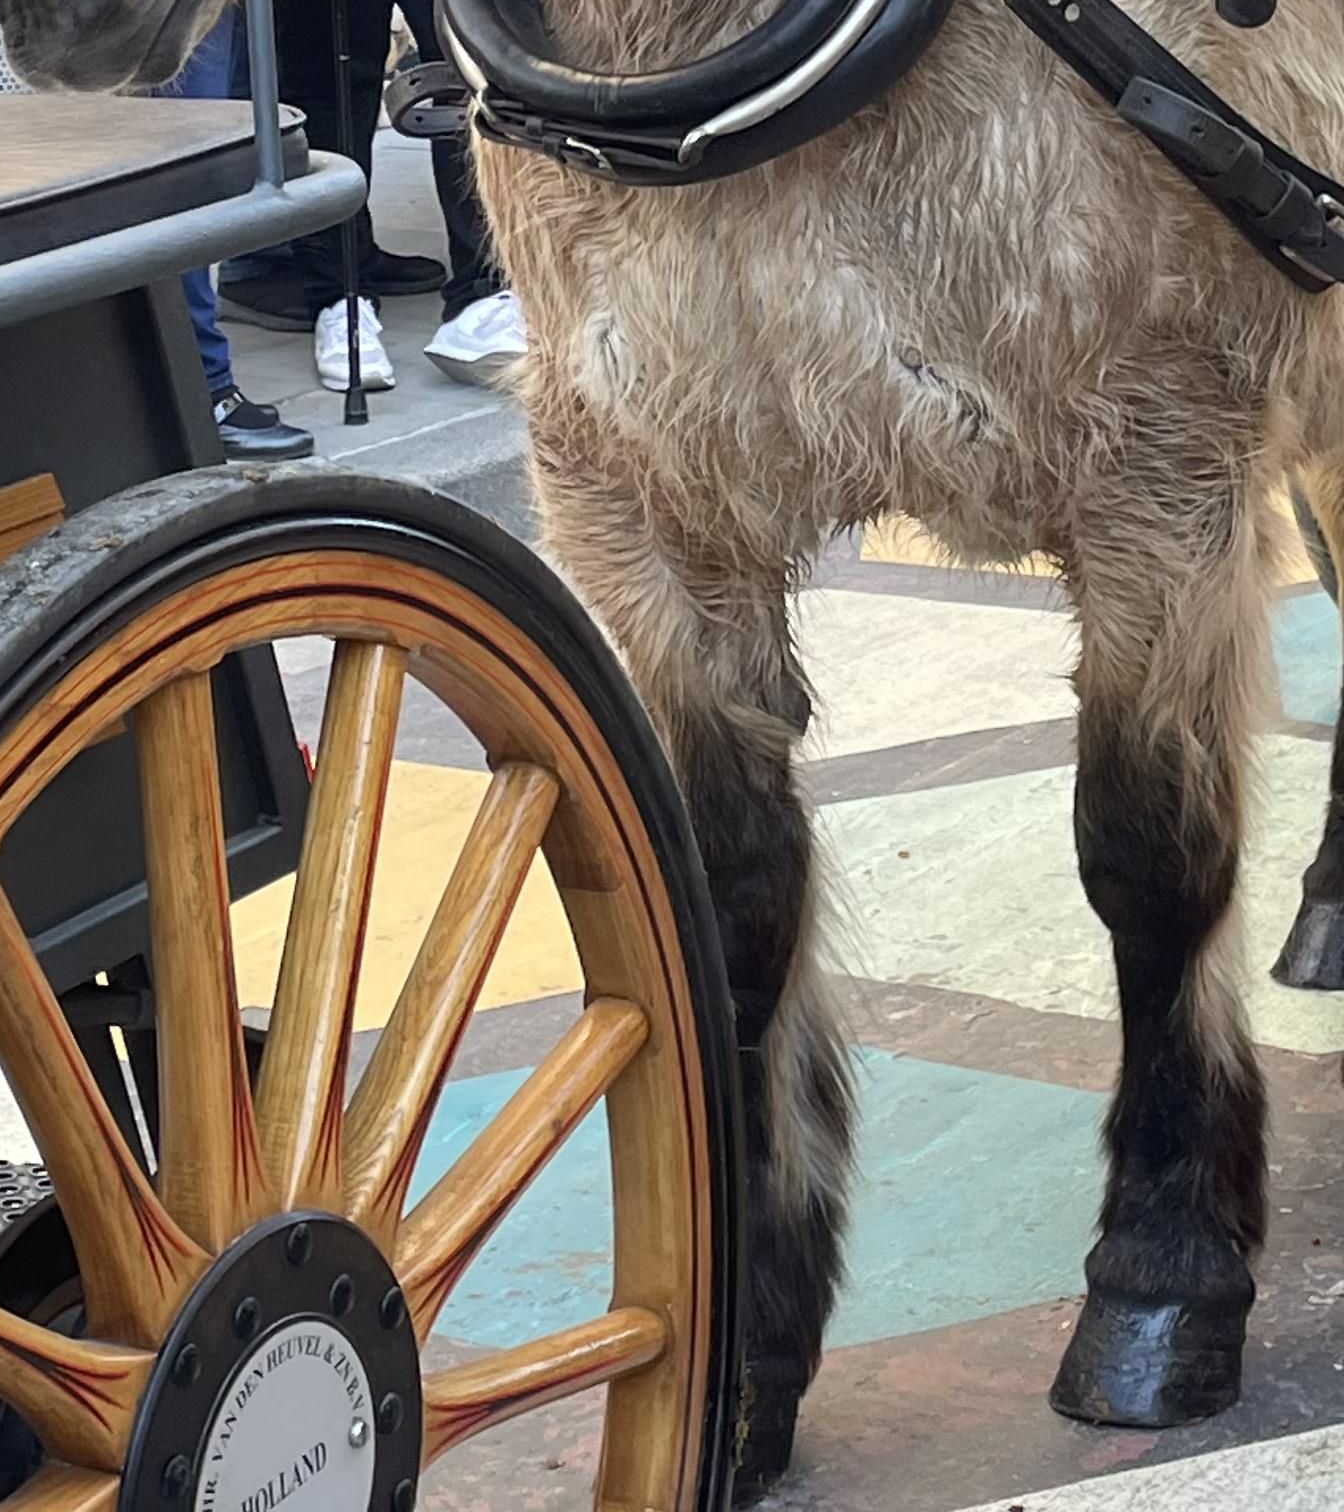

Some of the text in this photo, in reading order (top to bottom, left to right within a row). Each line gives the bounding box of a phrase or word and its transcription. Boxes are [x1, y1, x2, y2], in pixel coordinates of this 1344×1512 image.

[212, 1410, 238, 1462] VAN
[234, 1361, 265, 1410] DEN
[266, 1335, 322, 1374] HEUVEL
[322, 1343, 333, 1365] &
